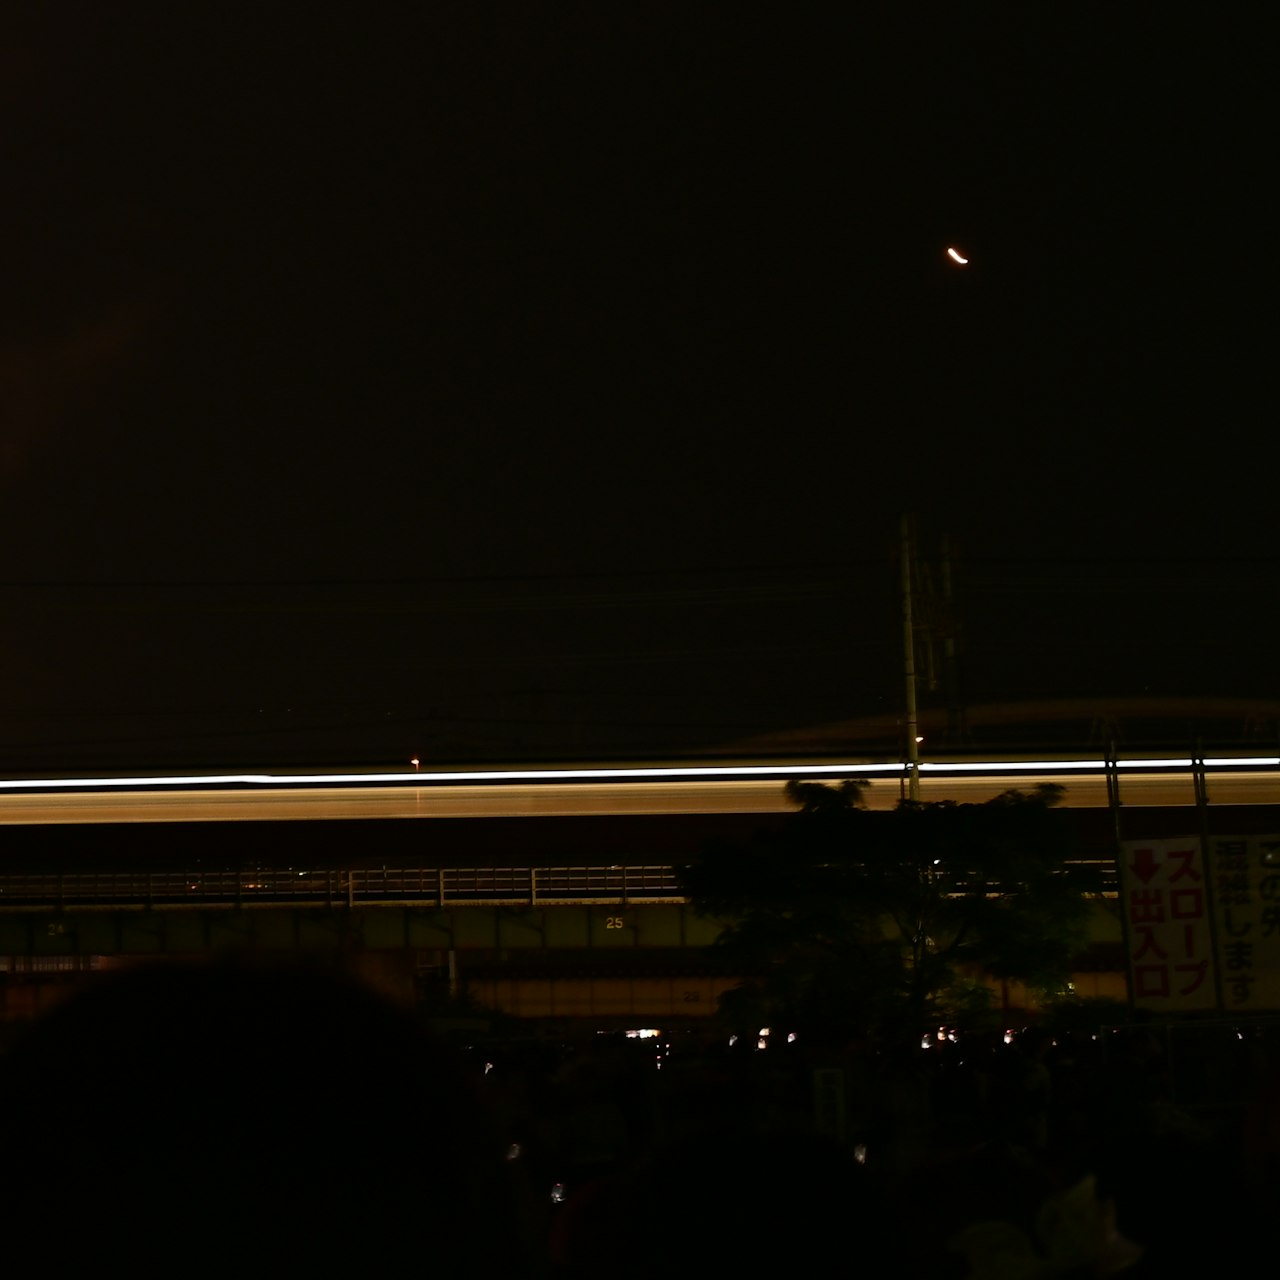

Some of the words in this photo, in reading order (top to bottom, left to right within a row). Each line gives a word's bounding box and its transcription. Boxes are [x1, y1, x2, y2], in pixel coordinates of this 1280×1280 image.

[606, 916, 624, 929] 25
[1130, 888, 1170, 998] 出入口
[1167, 849, 1209, 996] スロープ
